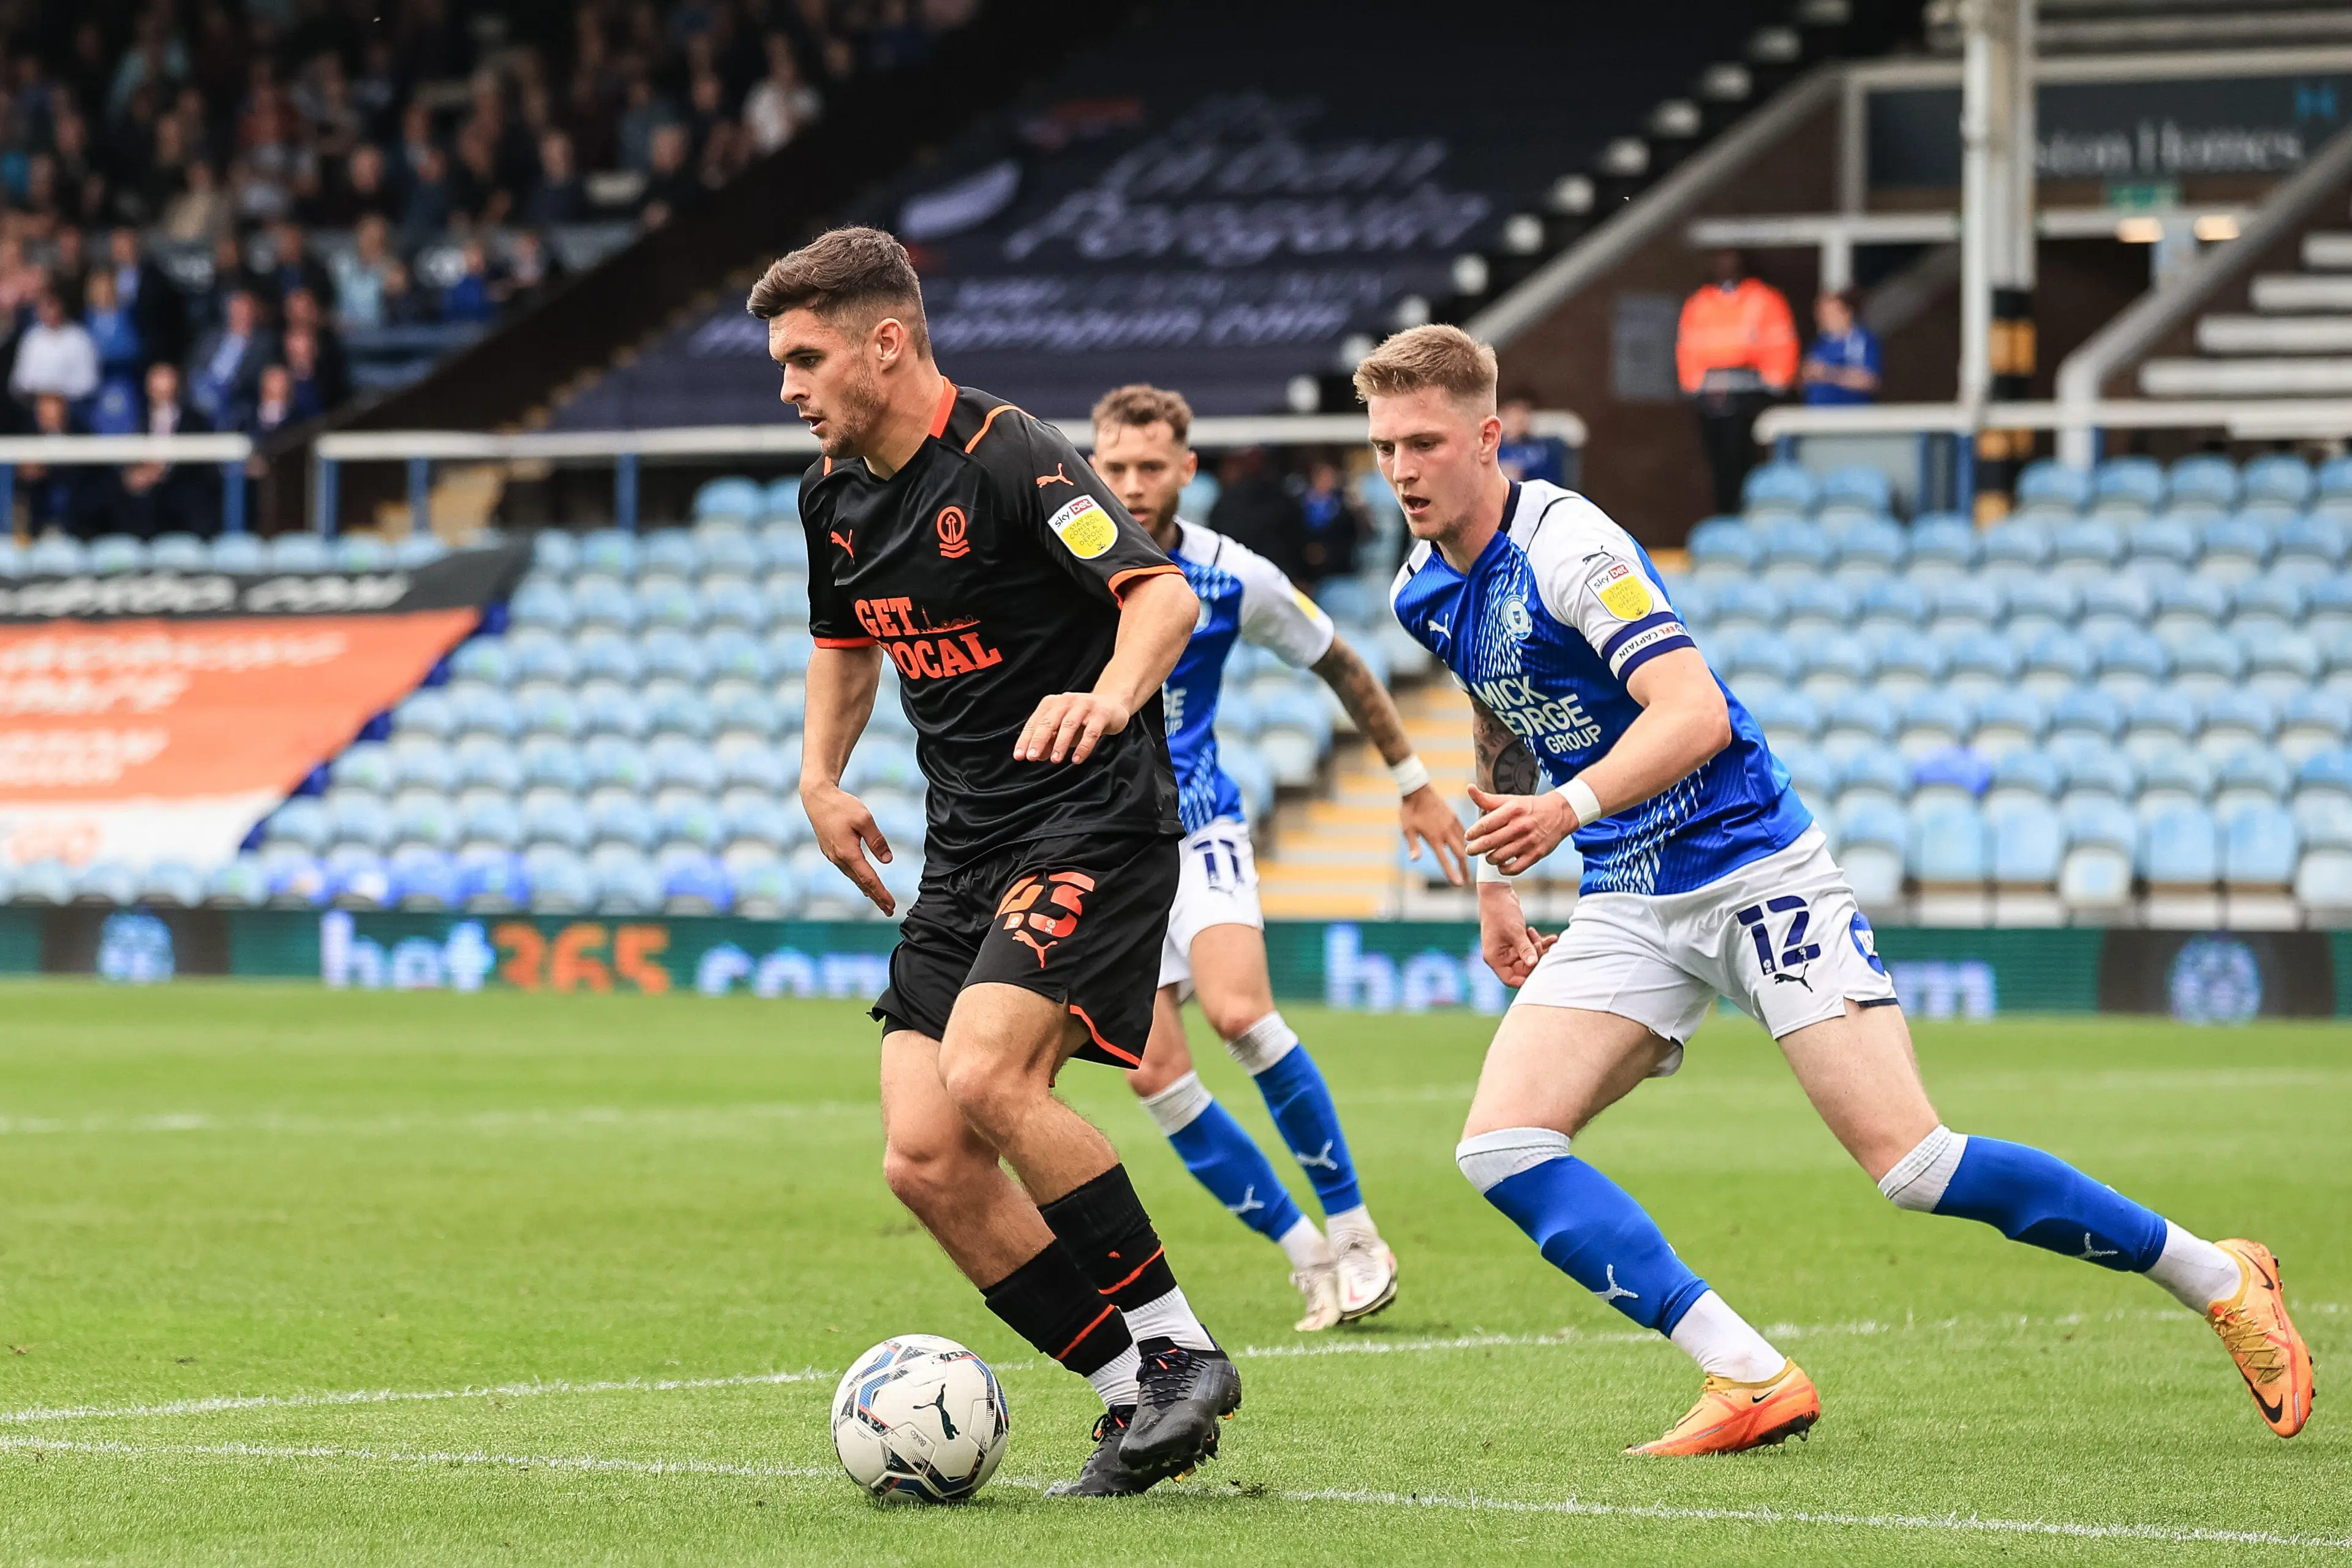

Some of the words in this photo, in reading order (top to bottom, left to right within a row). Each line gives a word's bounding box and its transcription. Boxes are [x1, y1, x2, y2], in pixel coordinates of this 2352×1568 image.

[1055, 511, 1070, 527] sky
[1070, 499, 1091, 513] bet
[1069, 519, 1084, 531] STAY
[1069, 517, 1101, 539] CONTROL
[1079, 526, 1105, 546] DEPOSIT
[1080, 528, 1090, 538] SET
[1087, 533, 1103, 547] LIMIT
[1594, 575, 1609, 589] sky
[854, 597, 920, 638] GET
[1659, 625, 1676, 635] EFL
[1619, 631, 1658, 659] CAPTAIN
[1471, 675, 1550, 710] MICK
[1494, 693, 1594, 739] EORGE
[1545, 724, 1602, 755] GROUP
[1736, 895, 1821, 976] 12
